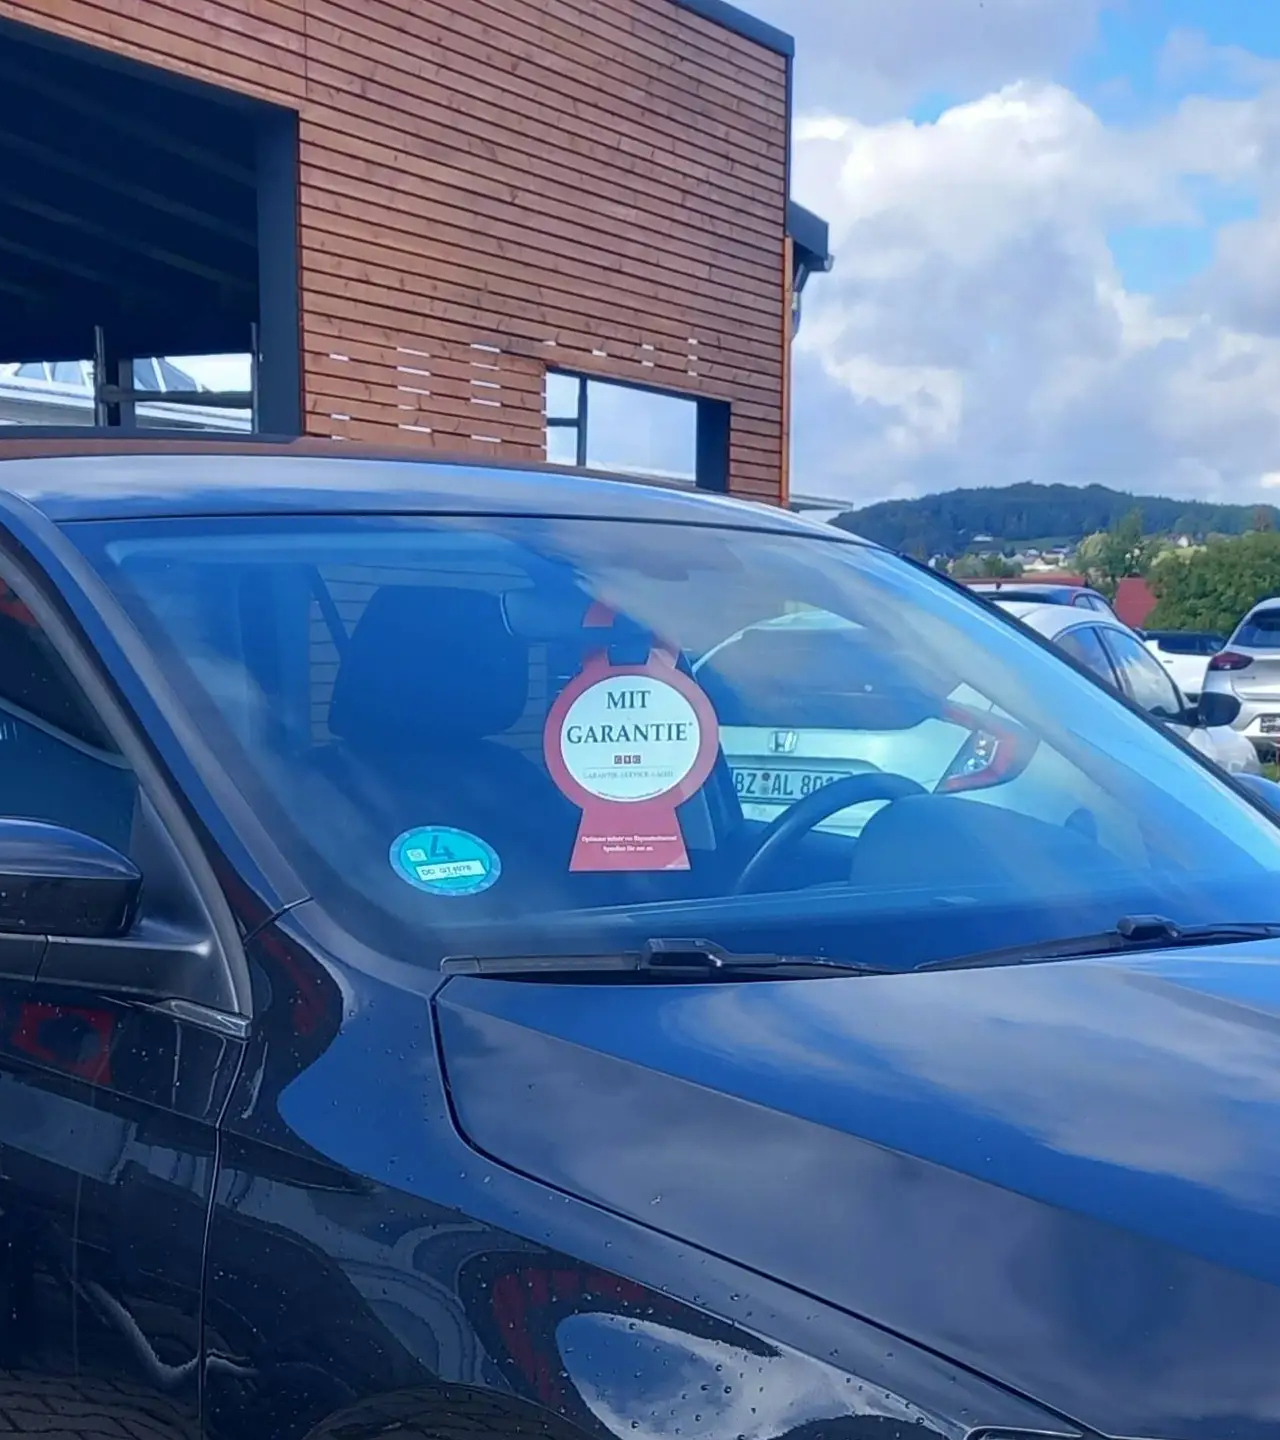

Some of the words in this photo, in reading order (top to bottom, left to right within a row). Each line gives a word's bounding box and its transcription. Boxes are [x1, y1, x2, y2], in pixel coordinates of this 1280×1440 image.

[606, 690, 651, 709] MIT
[734, 772, 758, 795] BZ
[770, 773, 794, 796] AL
[430, 835, 456, 859] 4
